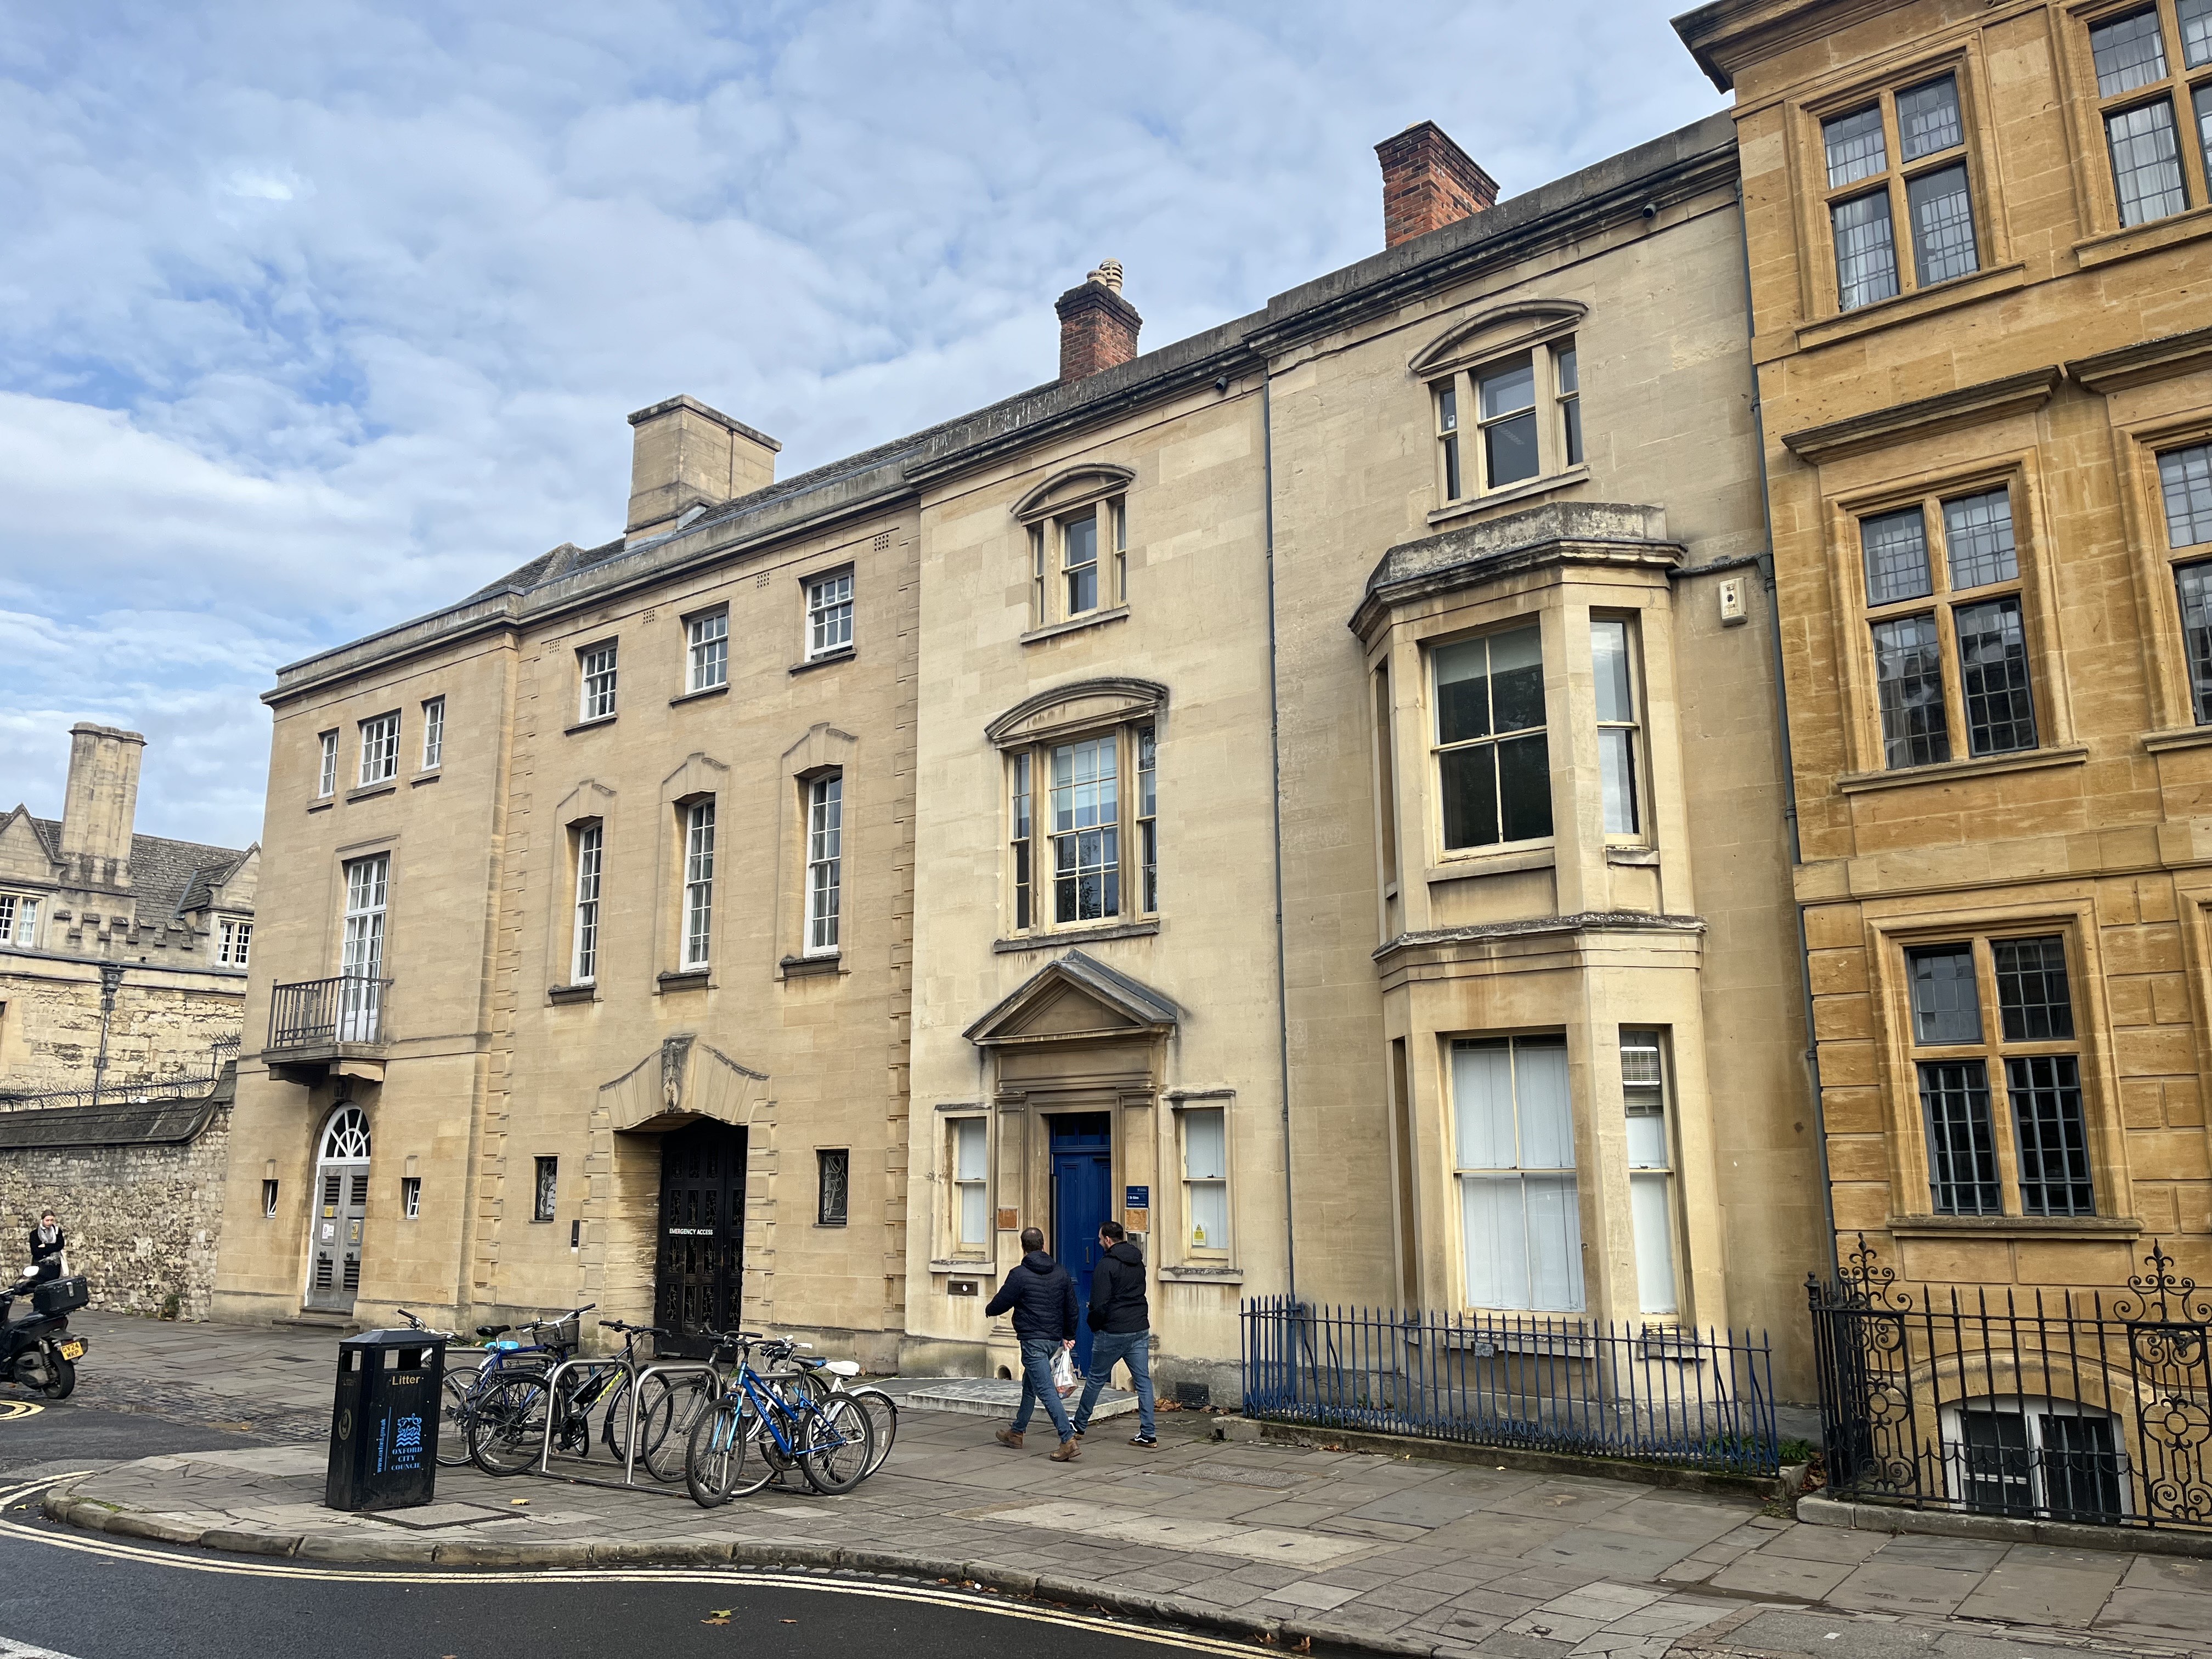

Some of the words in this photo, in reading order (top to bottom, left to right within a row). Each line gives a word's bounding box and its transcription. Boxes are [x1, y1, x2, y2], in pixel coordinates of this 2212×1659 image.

[392, 1375, 421, 1385] Litter
[595, 1368, 624, 1403] TREK
[377, 1418, 386, 1473] www.oxford.gov.uk
[392, 1446, 422, 1455] OXFORD
[391, 1462, 421, 1471] COUNCIL
